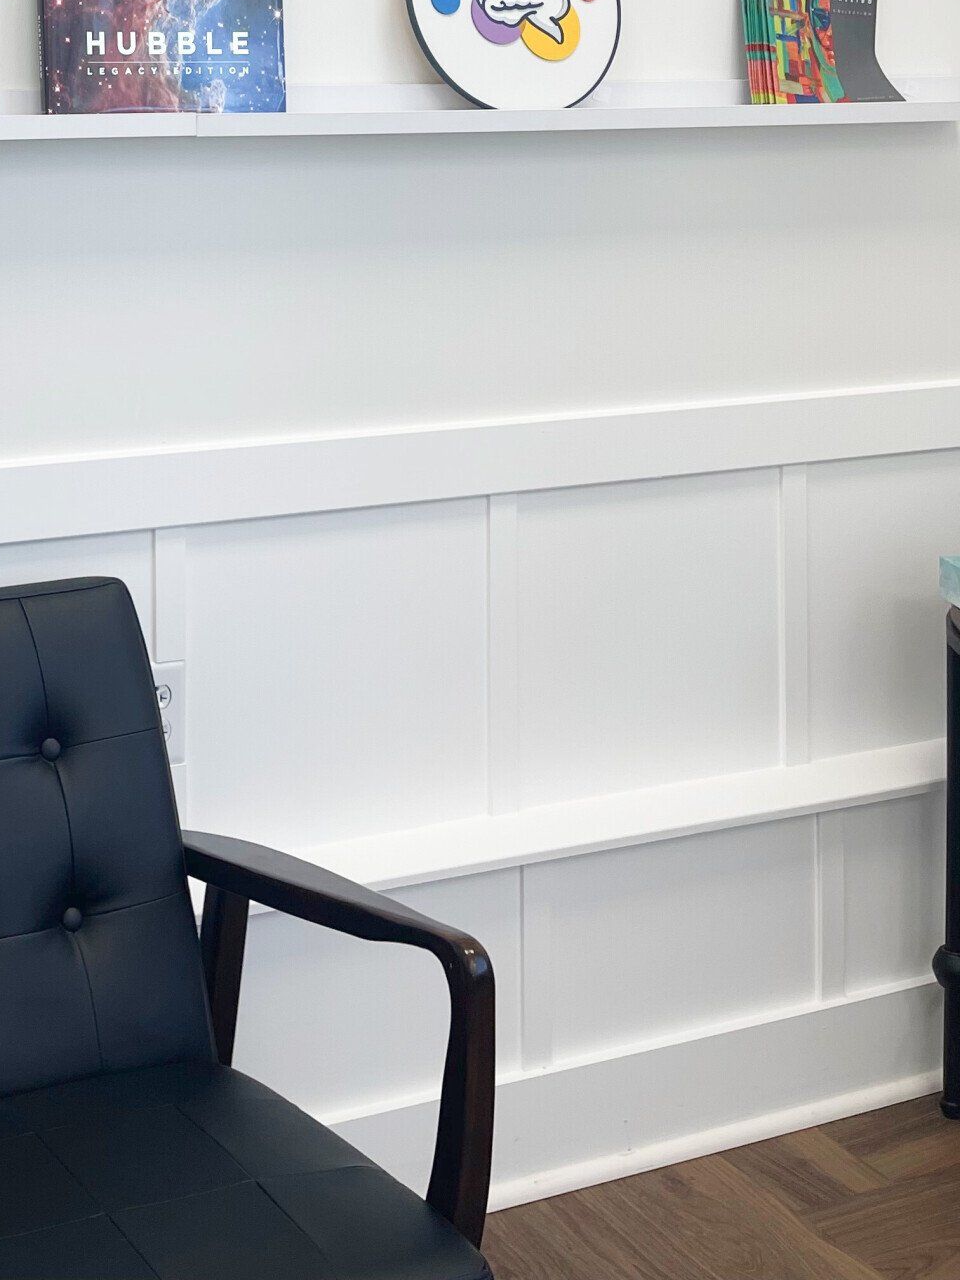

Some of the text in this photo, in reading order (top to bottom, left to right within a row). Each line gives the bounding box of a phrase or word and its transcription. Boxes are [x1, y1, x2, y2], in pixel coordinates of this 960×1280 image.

[86, 31, 250, 56] HUBBLE
[87, 66, 250, 76] LEGACY EDITION
